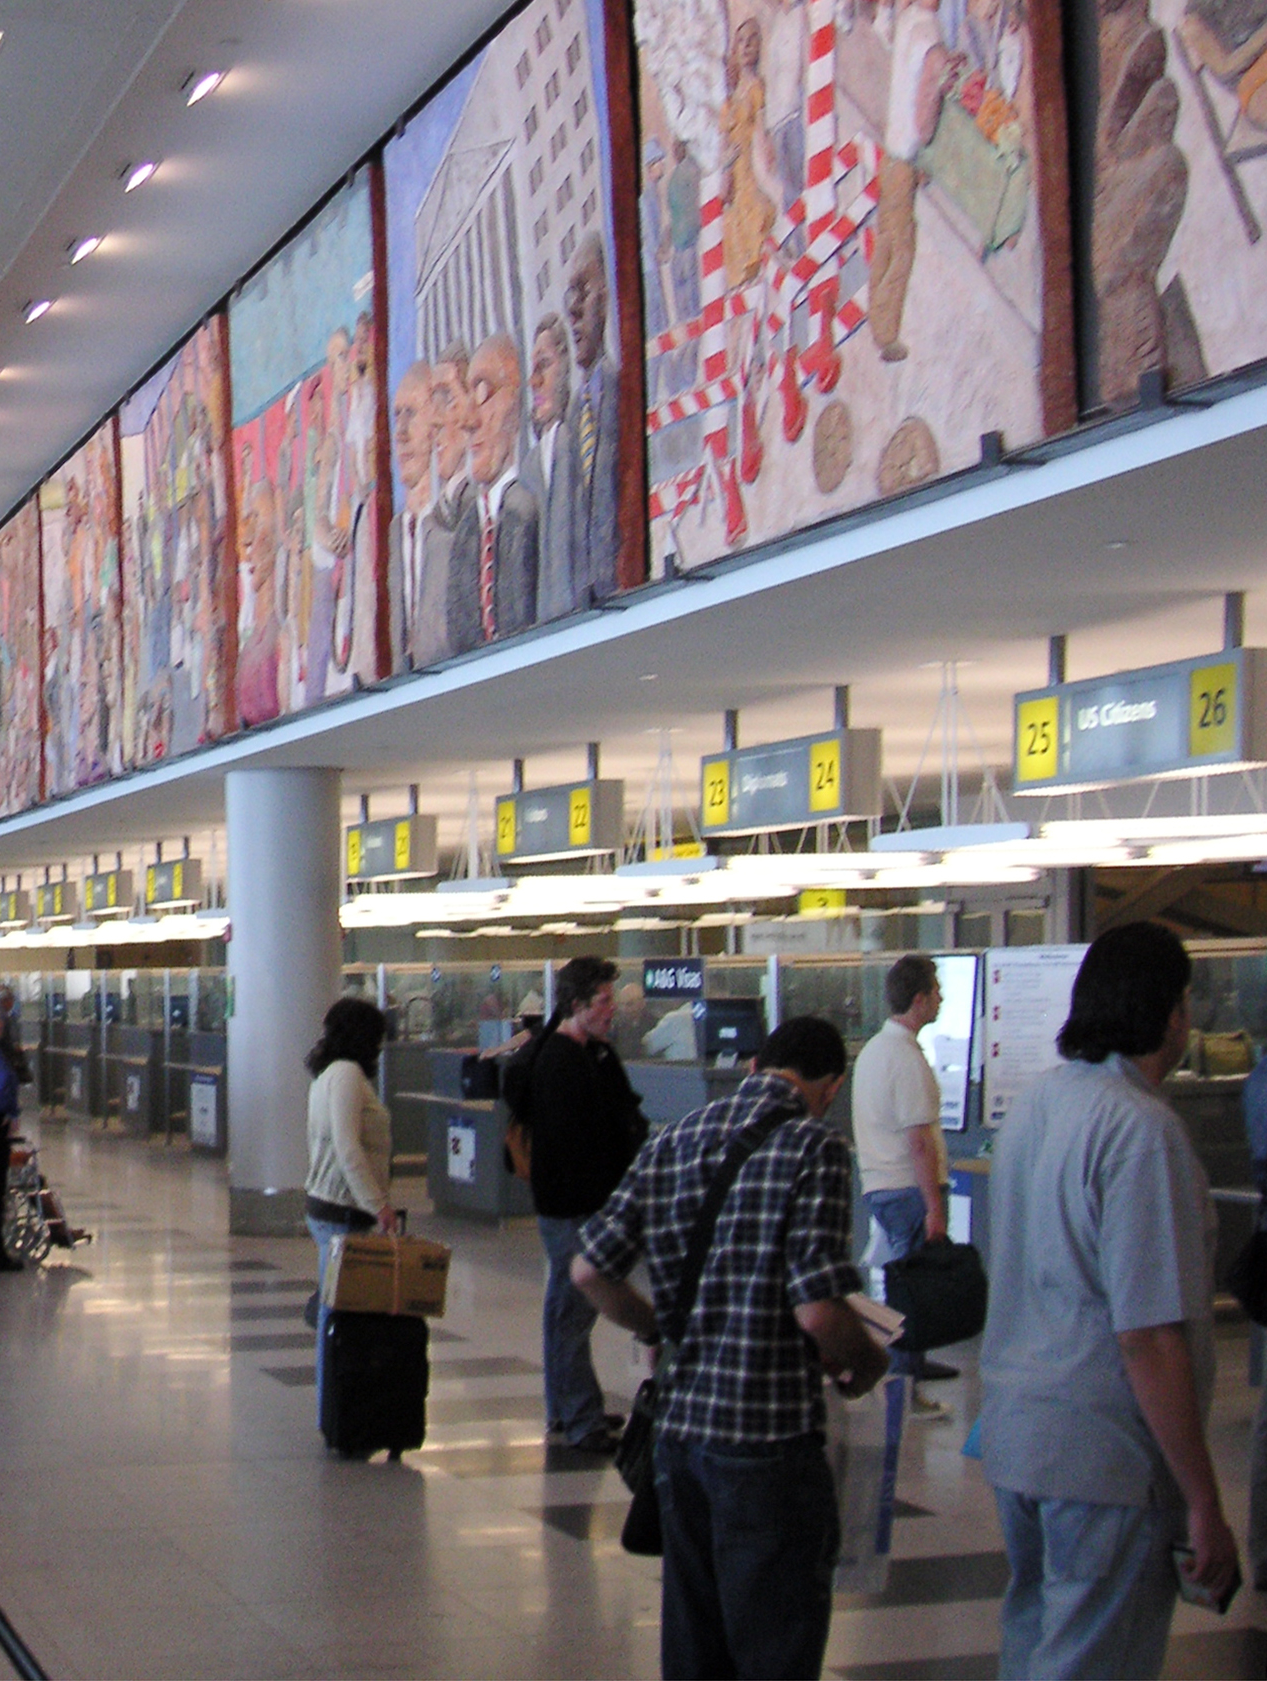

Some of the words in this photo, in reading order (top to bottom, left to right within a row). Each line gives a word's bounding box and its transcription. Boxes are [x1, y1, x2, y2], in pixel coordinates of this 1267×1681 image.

[1077, 705, 1099, 731] US
[1100, 699, 1157, 727] Citizens
[1198, 687, 1226, 729] 26
[1026, 720, 1052, 757] 25
[816, 759, 835, 791] 24
[709, 778, 725, 807] 23
[573, 803, 587, 829] 22
